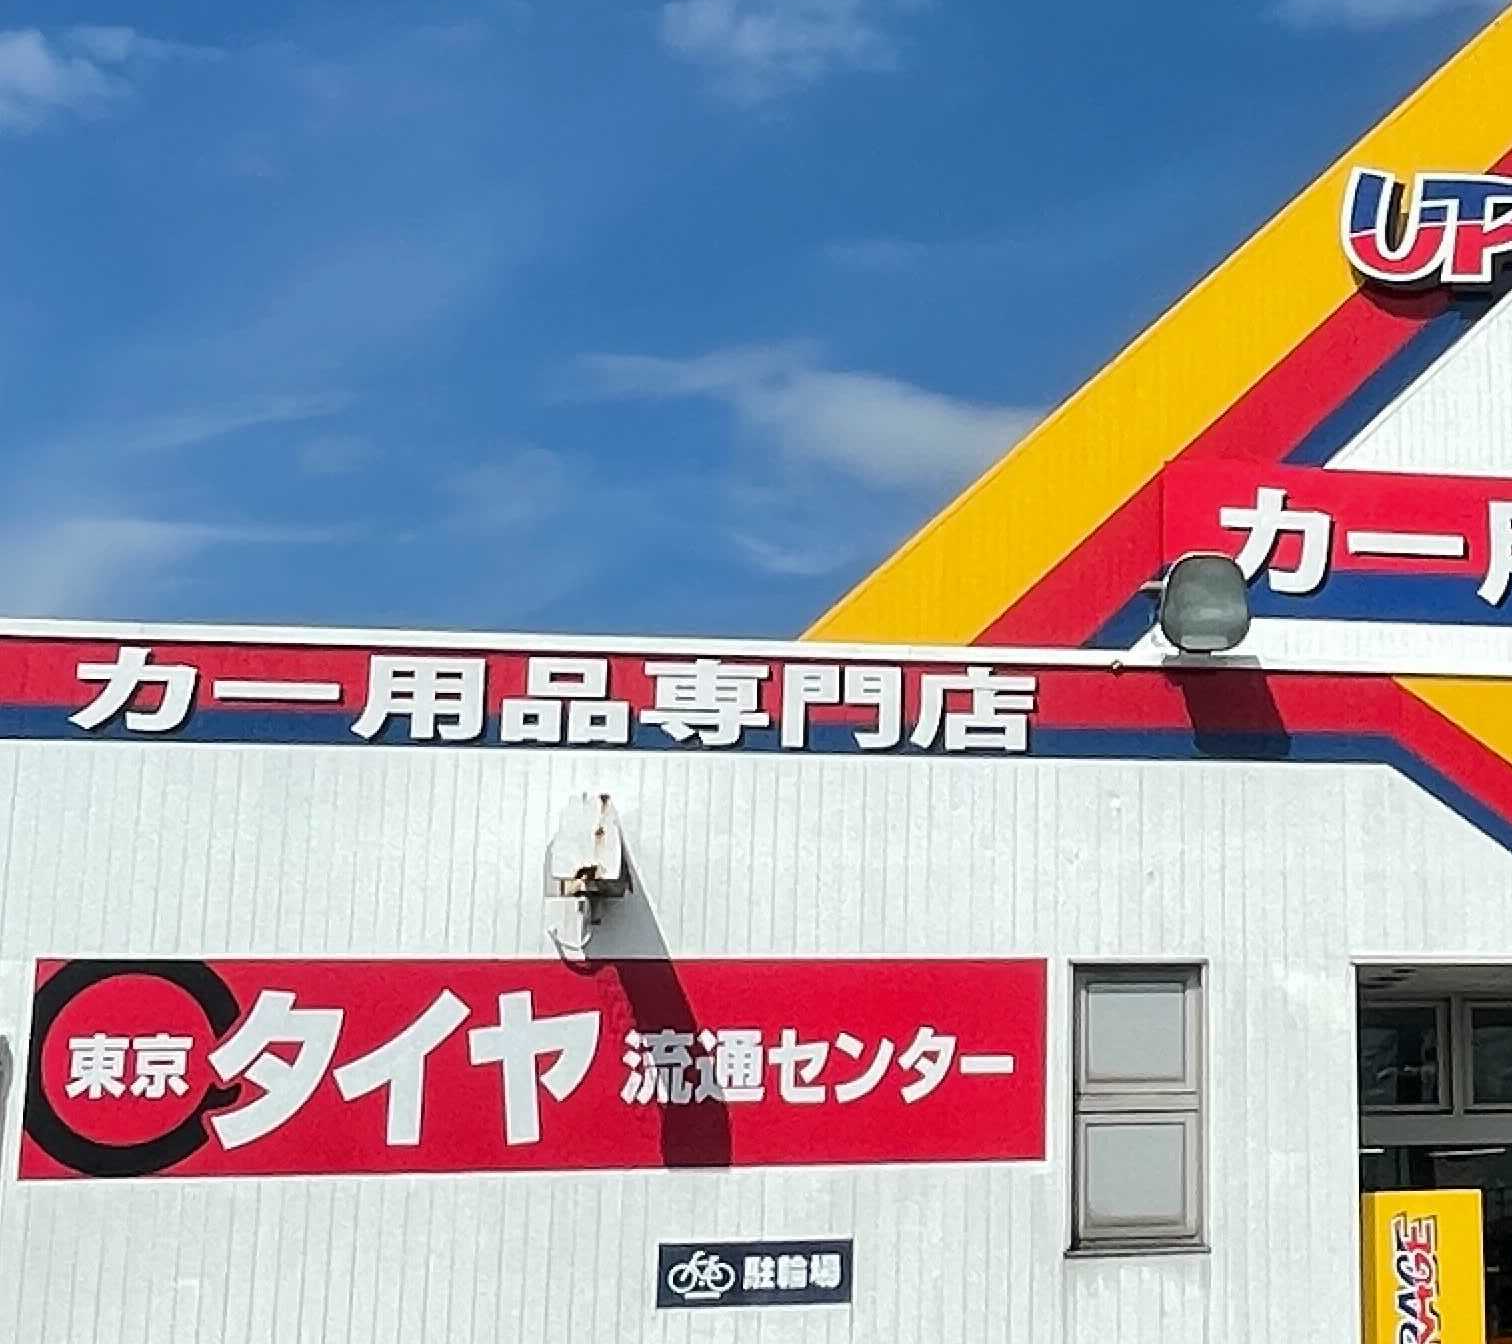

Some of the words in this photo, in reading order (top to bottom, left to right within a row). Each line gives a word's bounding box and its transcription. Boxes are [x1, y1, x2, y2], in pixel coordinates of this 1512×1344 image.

[69, 646, 1037, 752] カー用品専門店
[66, 1034, 192, 1100] 東京
[207, 989, 600, 1151] タイヤ
[620, 1026, 1014, 1106] 流通センター
